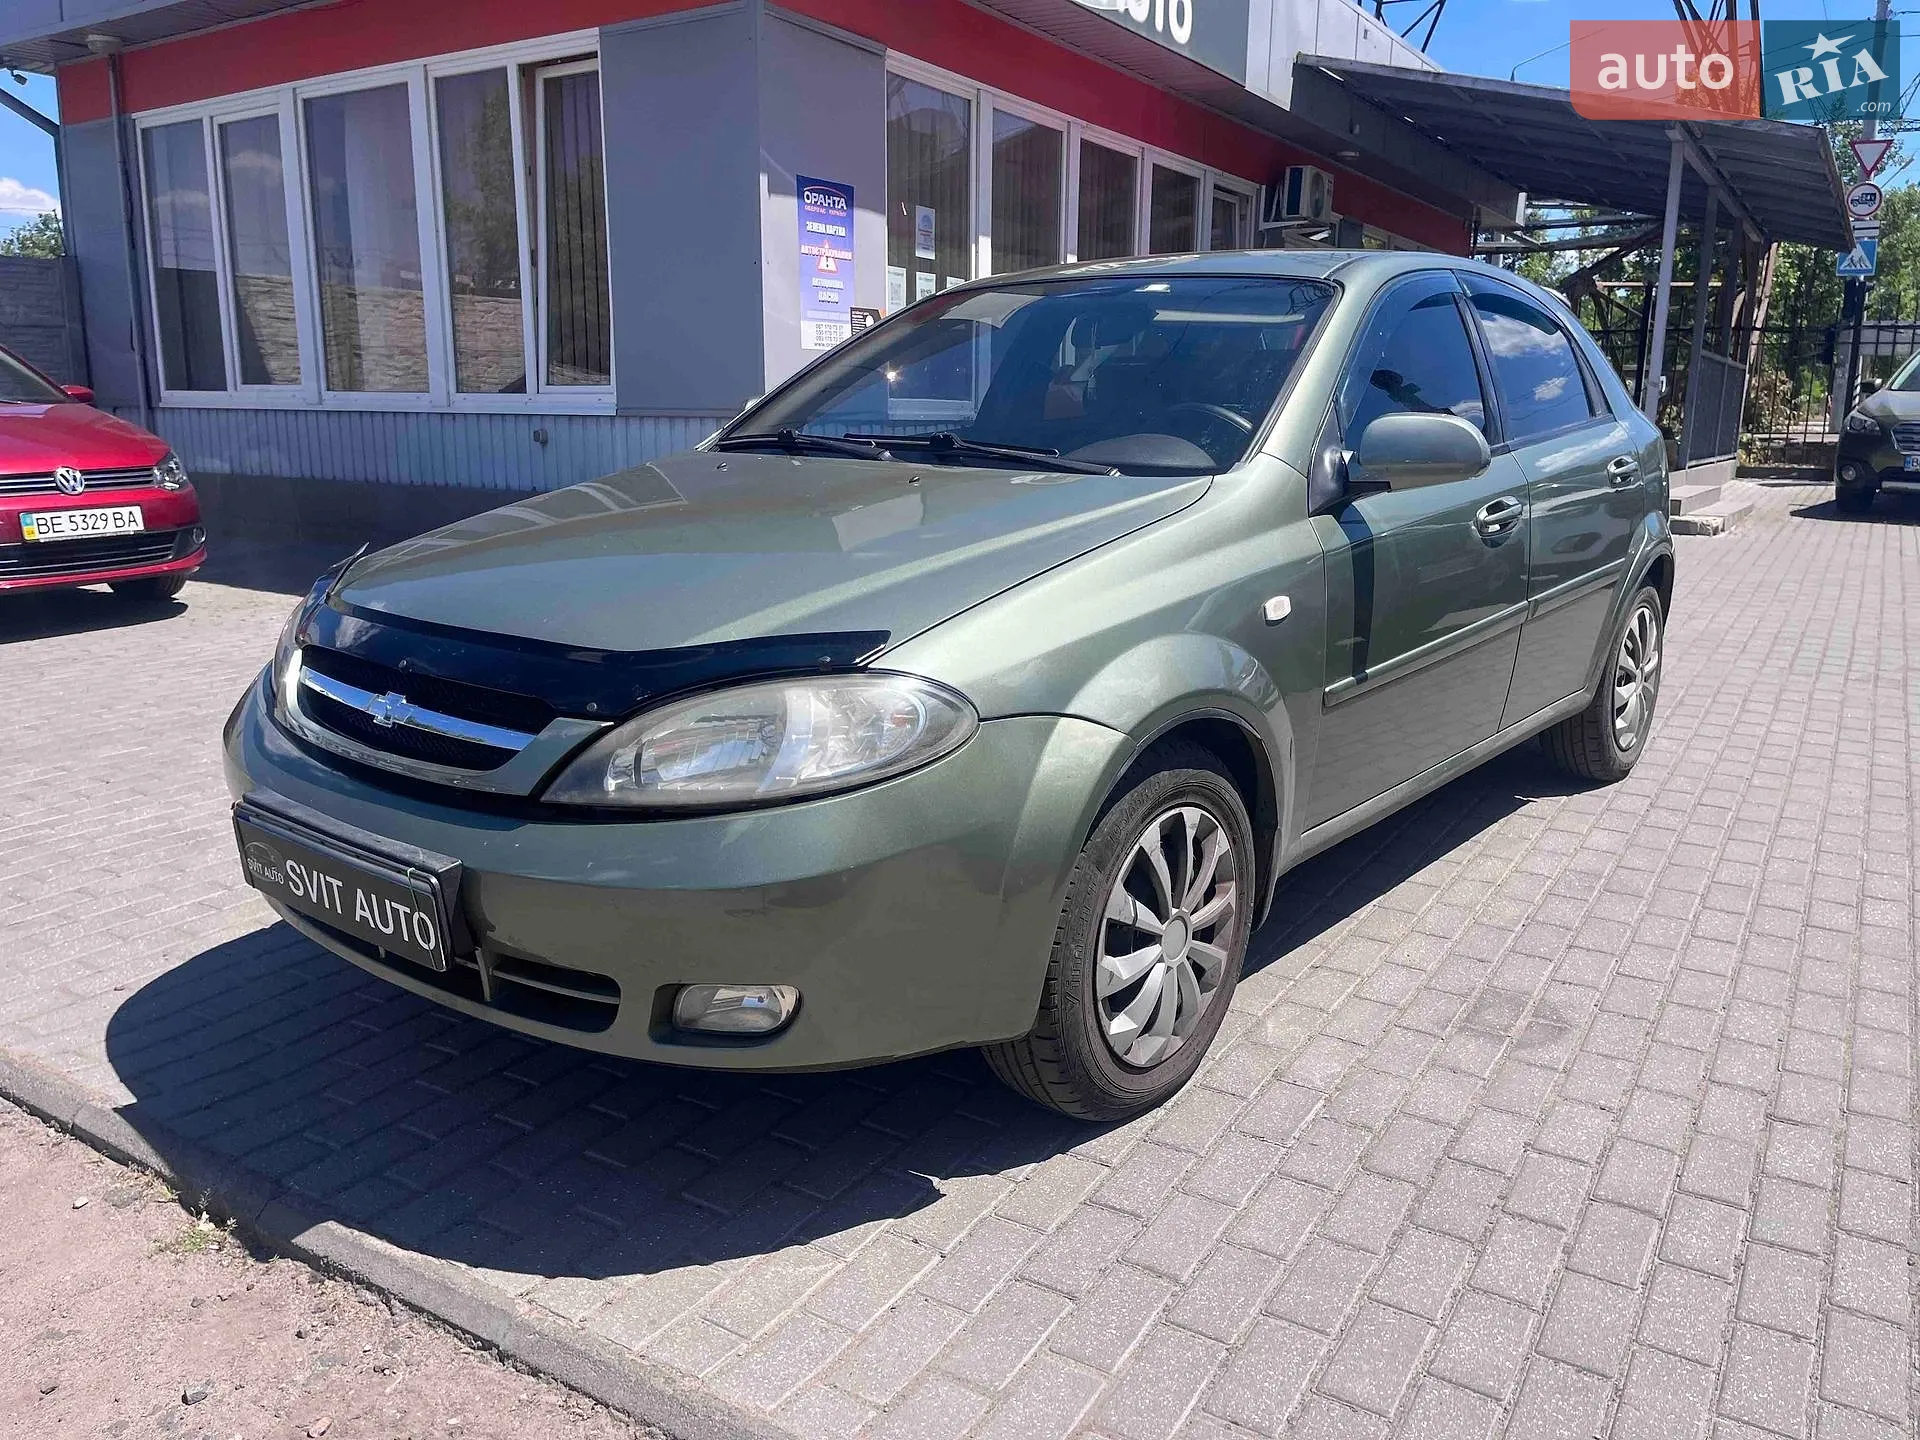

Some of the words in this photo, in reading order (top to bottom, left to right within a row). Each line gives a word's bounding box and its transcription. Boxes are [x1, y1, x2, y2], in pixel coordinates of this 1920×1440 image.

[803, 191, 848, 210] ОРАНТА
[36, 516, 64, 535] BE
[69, 512, 109, 532] 5329
[113, 511, 139, 529] BA
[247, 858, 263, 873] SVIT
[264, 866, 284, 885] AUTO
[285, 859, 344, 915] SVIT
[355, 888, 436, 951] AUTO
